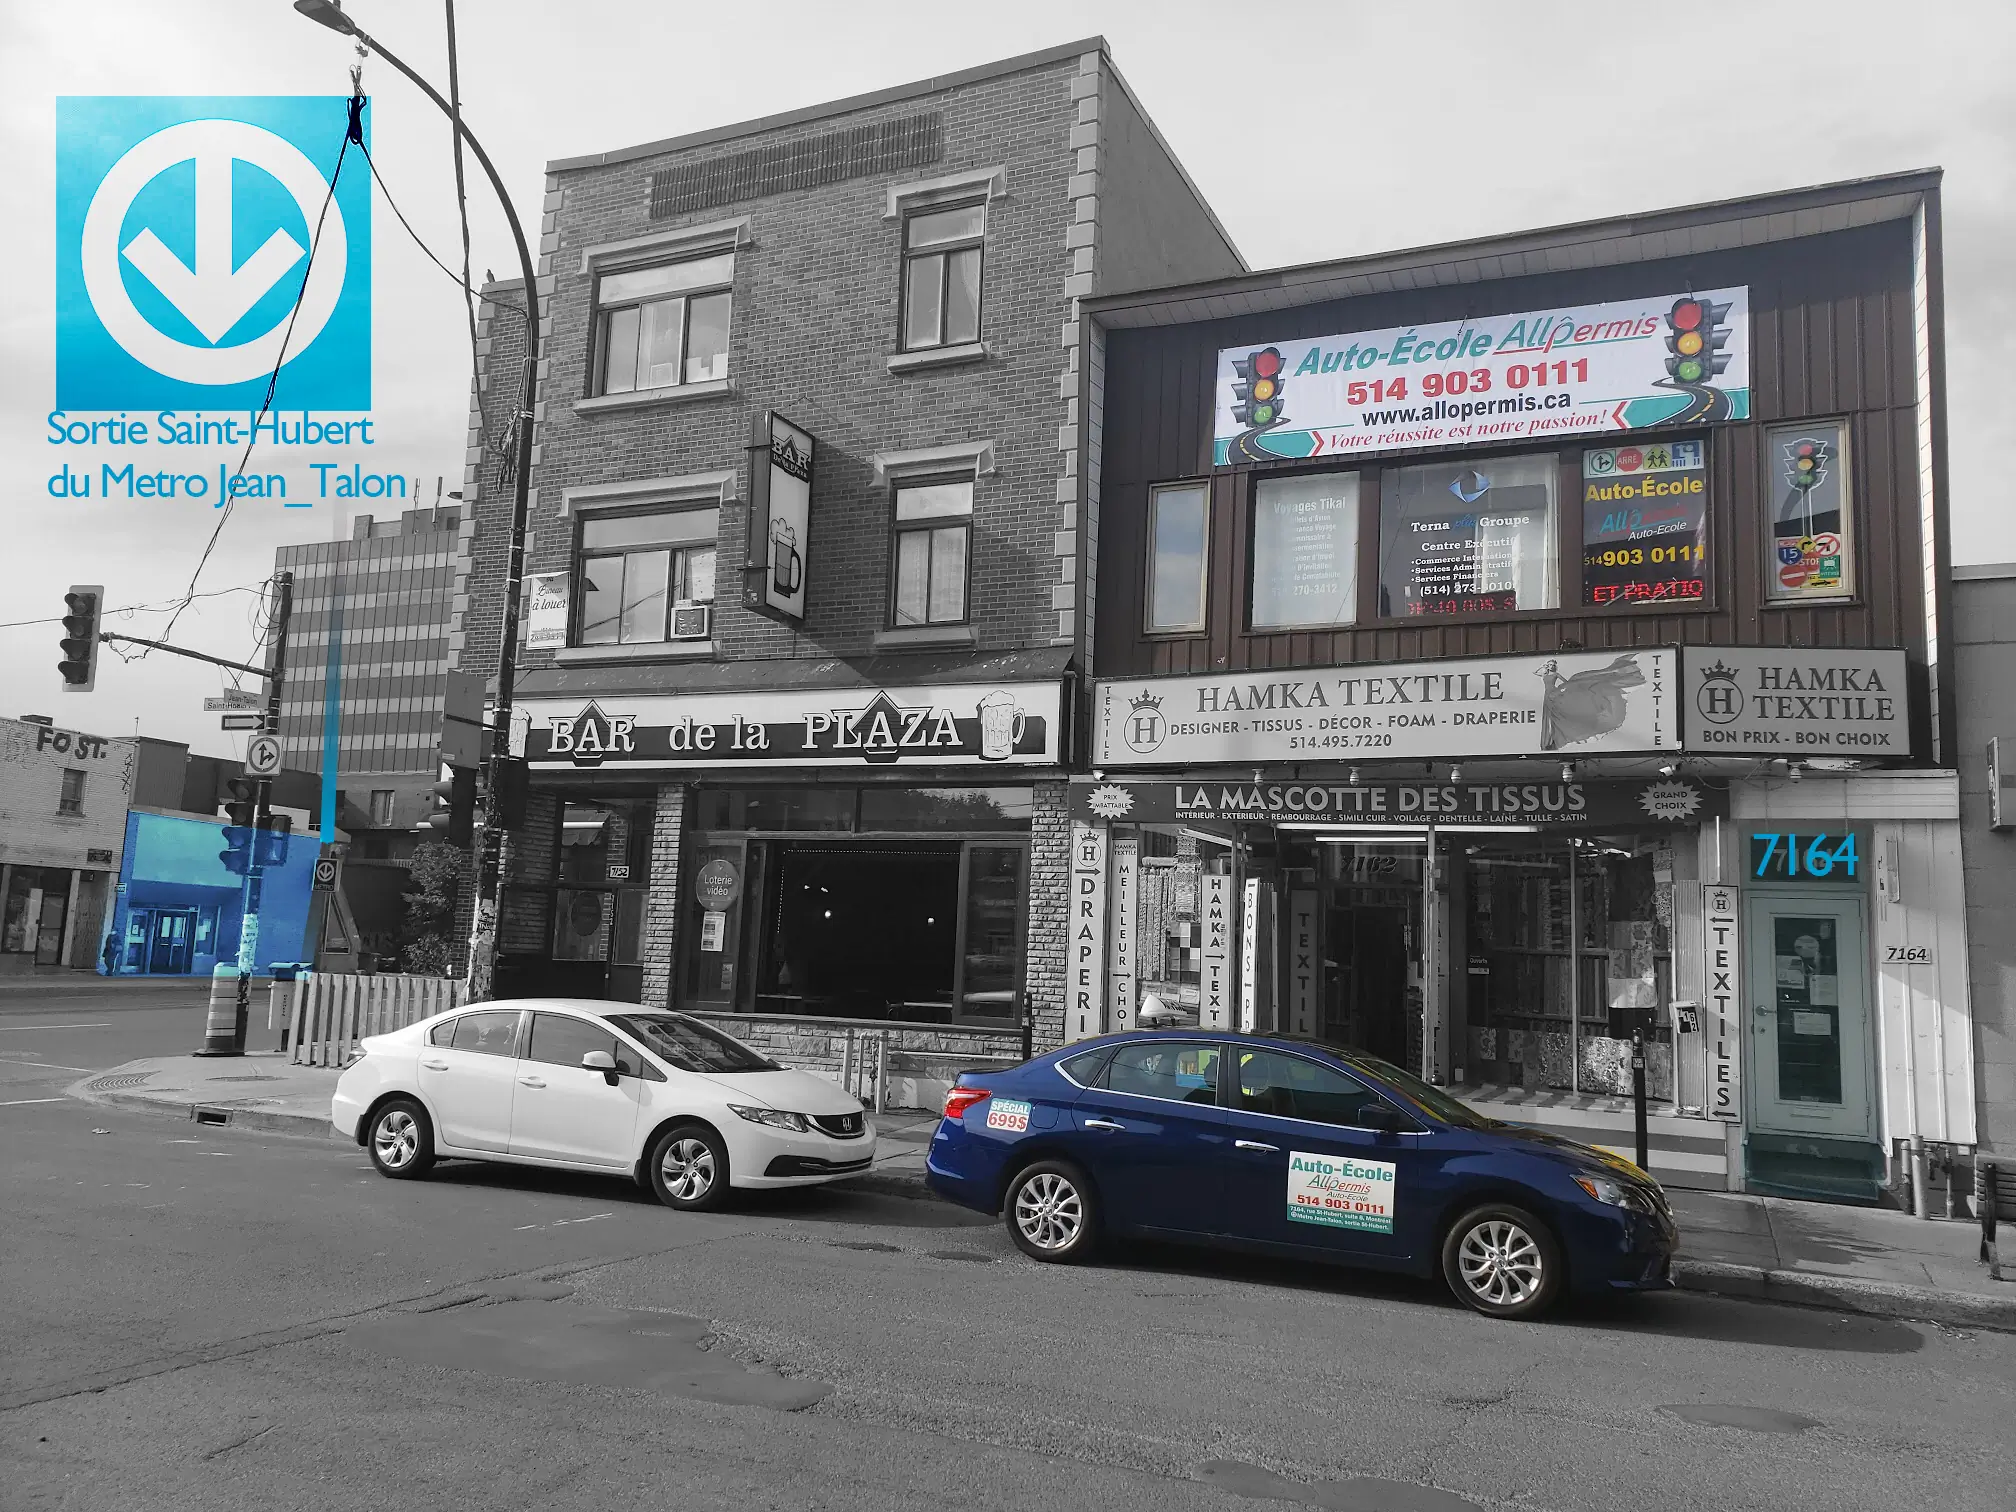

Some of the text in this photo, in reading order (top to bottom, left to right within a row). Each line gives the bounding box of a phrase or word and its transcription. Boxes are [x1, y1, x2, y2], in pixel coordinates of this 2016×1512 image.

[1294, 328, 1493, 377] Auto-École
[1347, 357, 1588, 405] 514 903 0111
[1362, 392, 1571, 427] www.allopermis.ca
[1331, 408, 1608, 449] Votre réussite est notre passion!
[771, 437, 810, 471] BAR
[1585, 475, 1704, 502] Auto-École
[1273, 496, 1346, 515] Voyages Tikal
[1411, 521, 1450, 532] Terna
[1479, 515, 1530, 530] Groupe
[1421, 541, 1461, 551] Centre
[1603, 548, 1644, 567] 903
[1651, 544, 1704, 564] 0111
[1782, 548, 1798, 559] 15
[1415, 555, 1461, 566] Commerce
[1415, 566, 1451, 575] Services
[1415, 571, 1499, 584] Services Financers
[1420, 585, 1450, 598] (514)
[1594, 584, 1620, 603] ET
[541, 598, 566, 610] louer
[1757, 666, 1887, 693] HAMKA
[1196, 671, 1505, 713] HAMKA TEXTILE
[1652, 654, 1663, 747] TEXTILE
[1752, 695, 1895, 722] TEXTILE
[548, 707, 964, 753] BAR de la PLAZA
[1103, 685, 1112, 760] TEXTILE
[1170, 709, 1536, 736] DESIGNER TISSUS DÉCOR FOAM DRAPERIE
[1289, 733, 1392, 750] 514.495.7220
[1703, 728, 1891, 747] BON PRIX BON CHOIX
[1175, 783, 1587, 812] LA MASCOTTE DES TISSUS
[1652, 790, 1688, 801] GRAND
[1654, 800, 1687, 811] CHOIX
[1271, 812, 1331, 821] REMBOURRAGE
[1338, 813, 1364, 822] SIMILI
[1365, 814, 1387, 822] CUIR
[1393, 814, 1432, 823] VOILAGE
[1439, 814, 1483, 823] DENTELLE
[1525, 813, 1553, 822] TULLE
[1560, 812, 1588, 822] SATIN
[704, 873, 733, 885] Loterie
[707, 886, 729, 896] vidéo
[1118, 864, 1130, 966] MEILLEUR
[1209, 878, 1223, 948] HAMKA
[1076, 877, 1097, 1041] DRAPERI
[1887, 947, 1927, 961] 7164
[1208, 965, 1221, 1028] TEXT
[1711, 926, 1732, 1107] TEXTILES
[991, 1100, 1030, 1114] SPÉCIAL
[988, 1111, 1028, 1130] 699$
[1291, 1158, 1393, 1182] Auto-École
[1297, 1194, 1385, 1215] 514 903 0111
